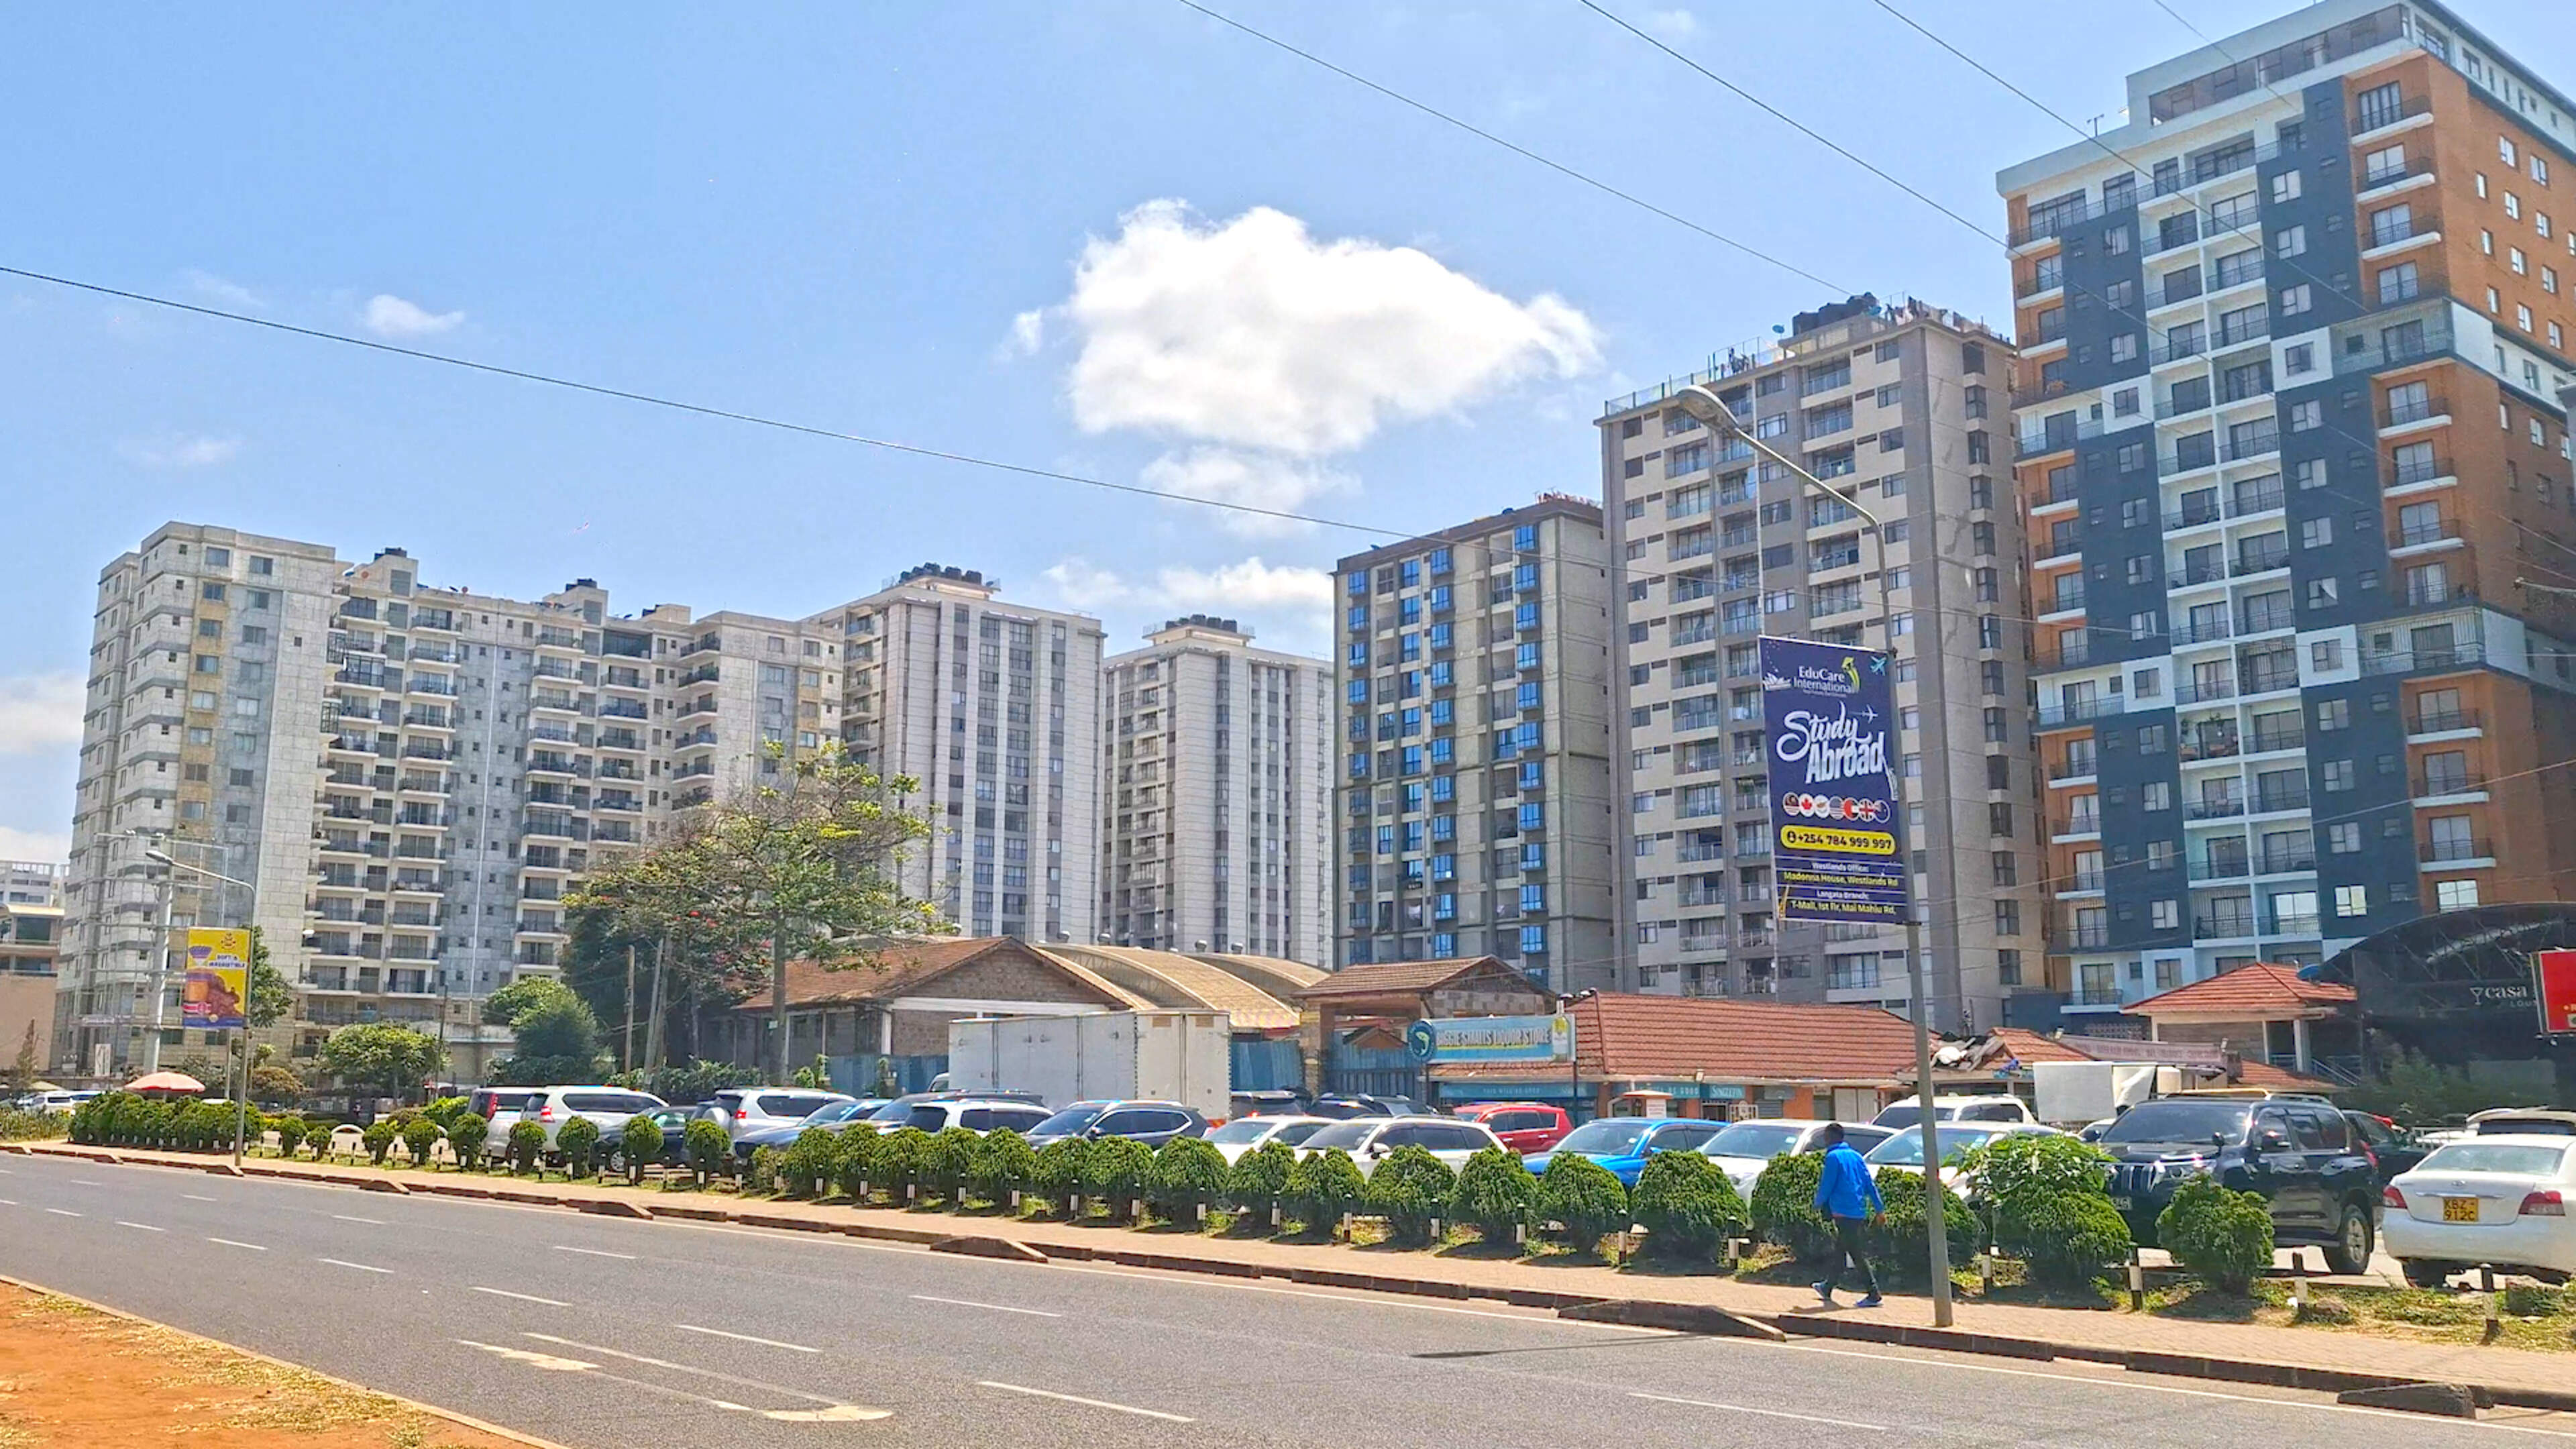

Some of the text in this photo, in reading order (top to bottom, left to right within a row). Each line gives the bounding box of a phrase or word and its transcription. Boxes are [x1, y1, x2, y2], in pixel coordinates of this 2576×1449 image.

[1799, 665, 1845, 682] EduCare
[1794, 676, 1856, 694] International
[1776, 700, 1873, 761] Study
[1805, 731, 1884, 784] Abroad
[1798, 834, 1892, 849] +254 784 999 997
[1784, 871, 1820, 882] Madonna
[1847, 875, 1886, 885] Westlands
[2484, 985, 2528, 999] casa
[2444, 1199, 2467, 1209] KBZ
[2444, 1211, 2475, 1221] 912C
